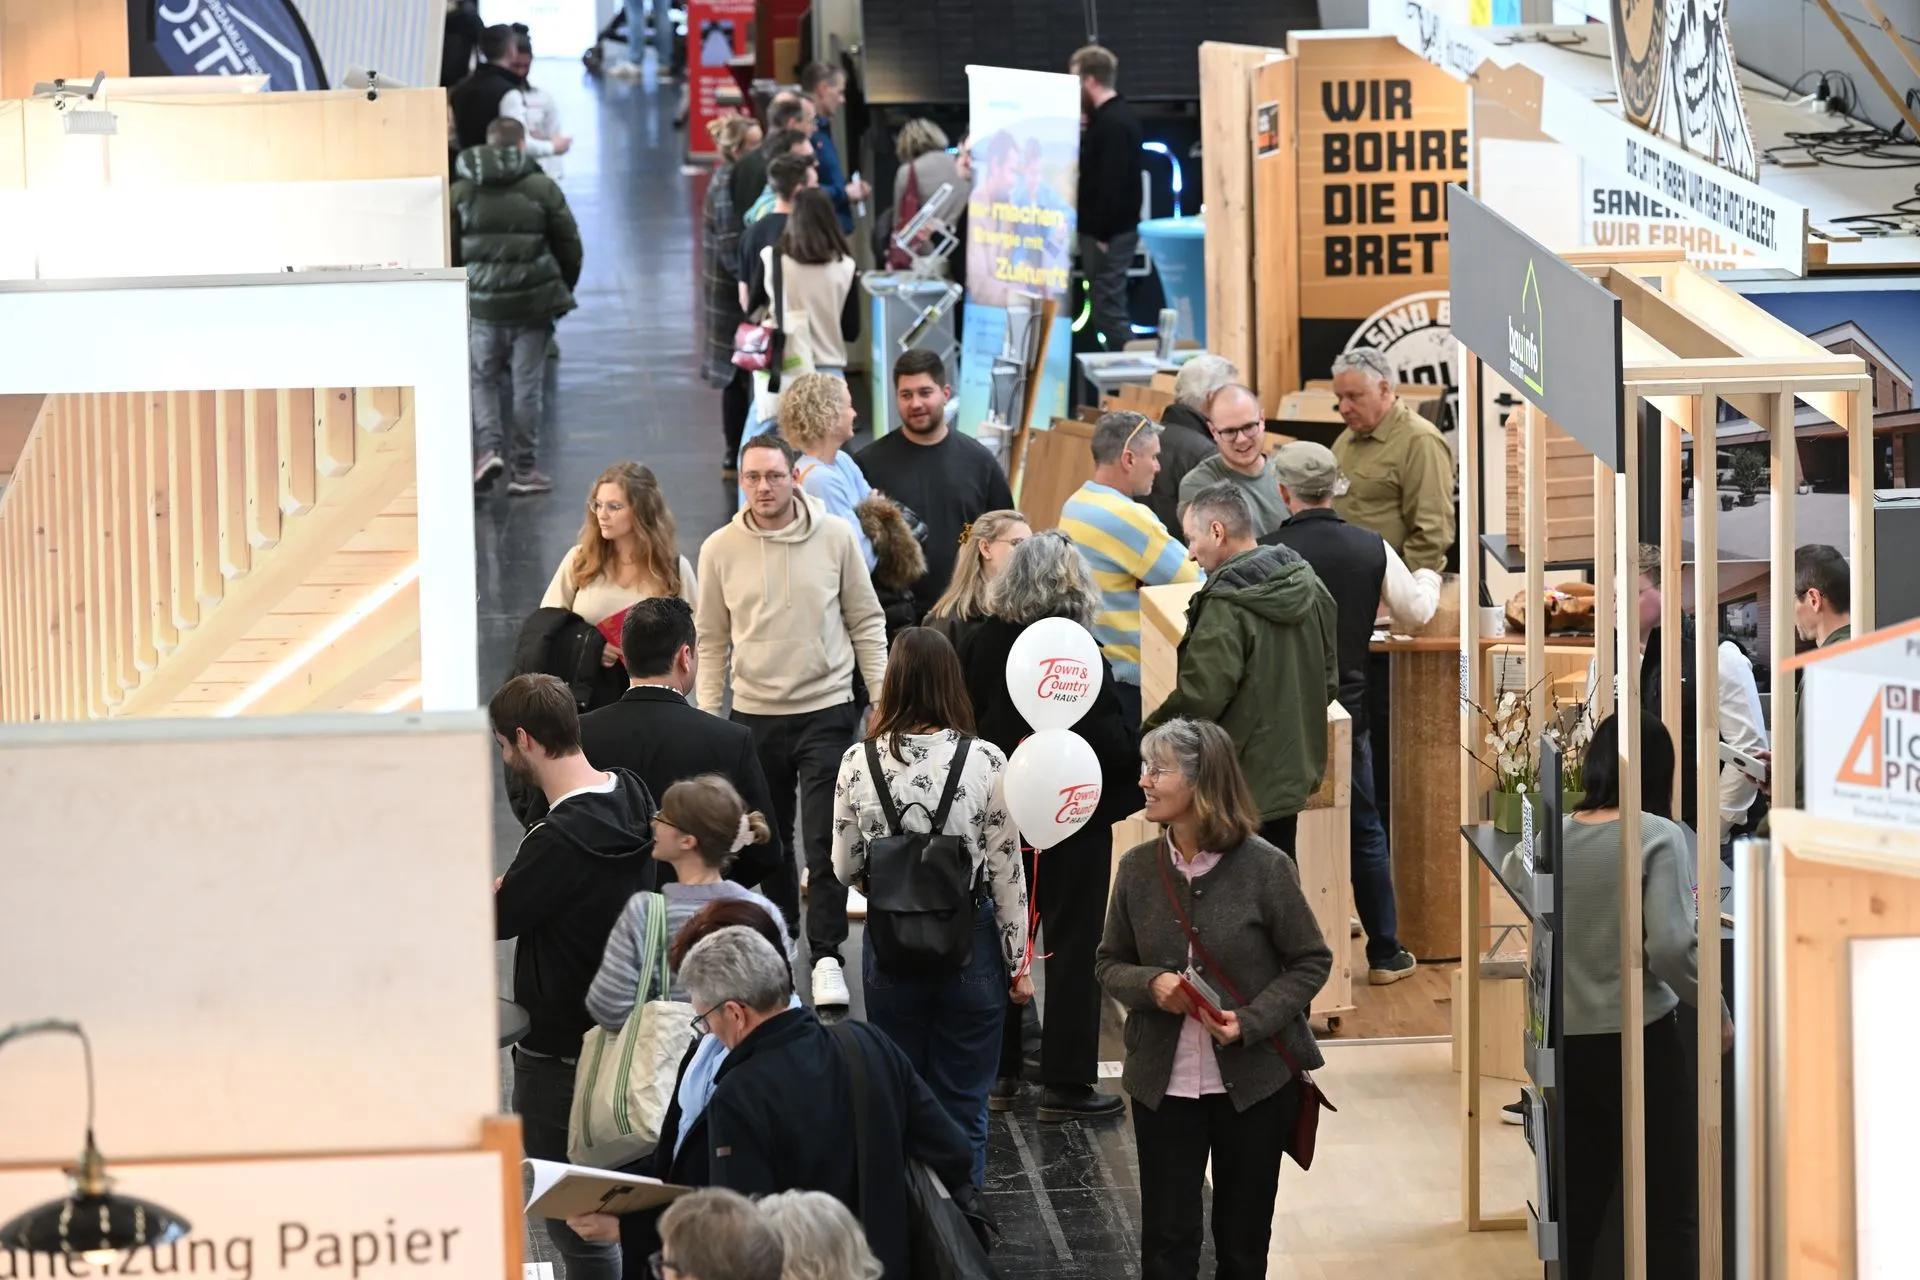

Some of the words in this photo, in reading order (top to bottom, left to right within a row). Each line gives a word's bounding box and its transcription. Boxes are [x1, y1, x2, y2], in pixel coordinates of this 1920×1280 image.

[1322, 79, 1412, 122] WIR
[1323, 130, 1468, 174] BOHRE
[1324, 182, 1396, 225] DIE
[1325, 233, 1449, 277] BRET
[1593, 220, 1640, 246] WIR
[1649, 223, 1755, 257] ERHAL
[1364, 301, 1430, 351] SIND
[1508, 315, 1539, 373] bauinfo
[1037, 674, 1090, 699] Country
[1039, 657, 1087, 677] Town
[1079, 667, 1088, 679] &
[1053, 693, 1079, 703] HAUS
[1055, 801, 1096, 823] Count
[278, 1217, 462, 1278] Papier
